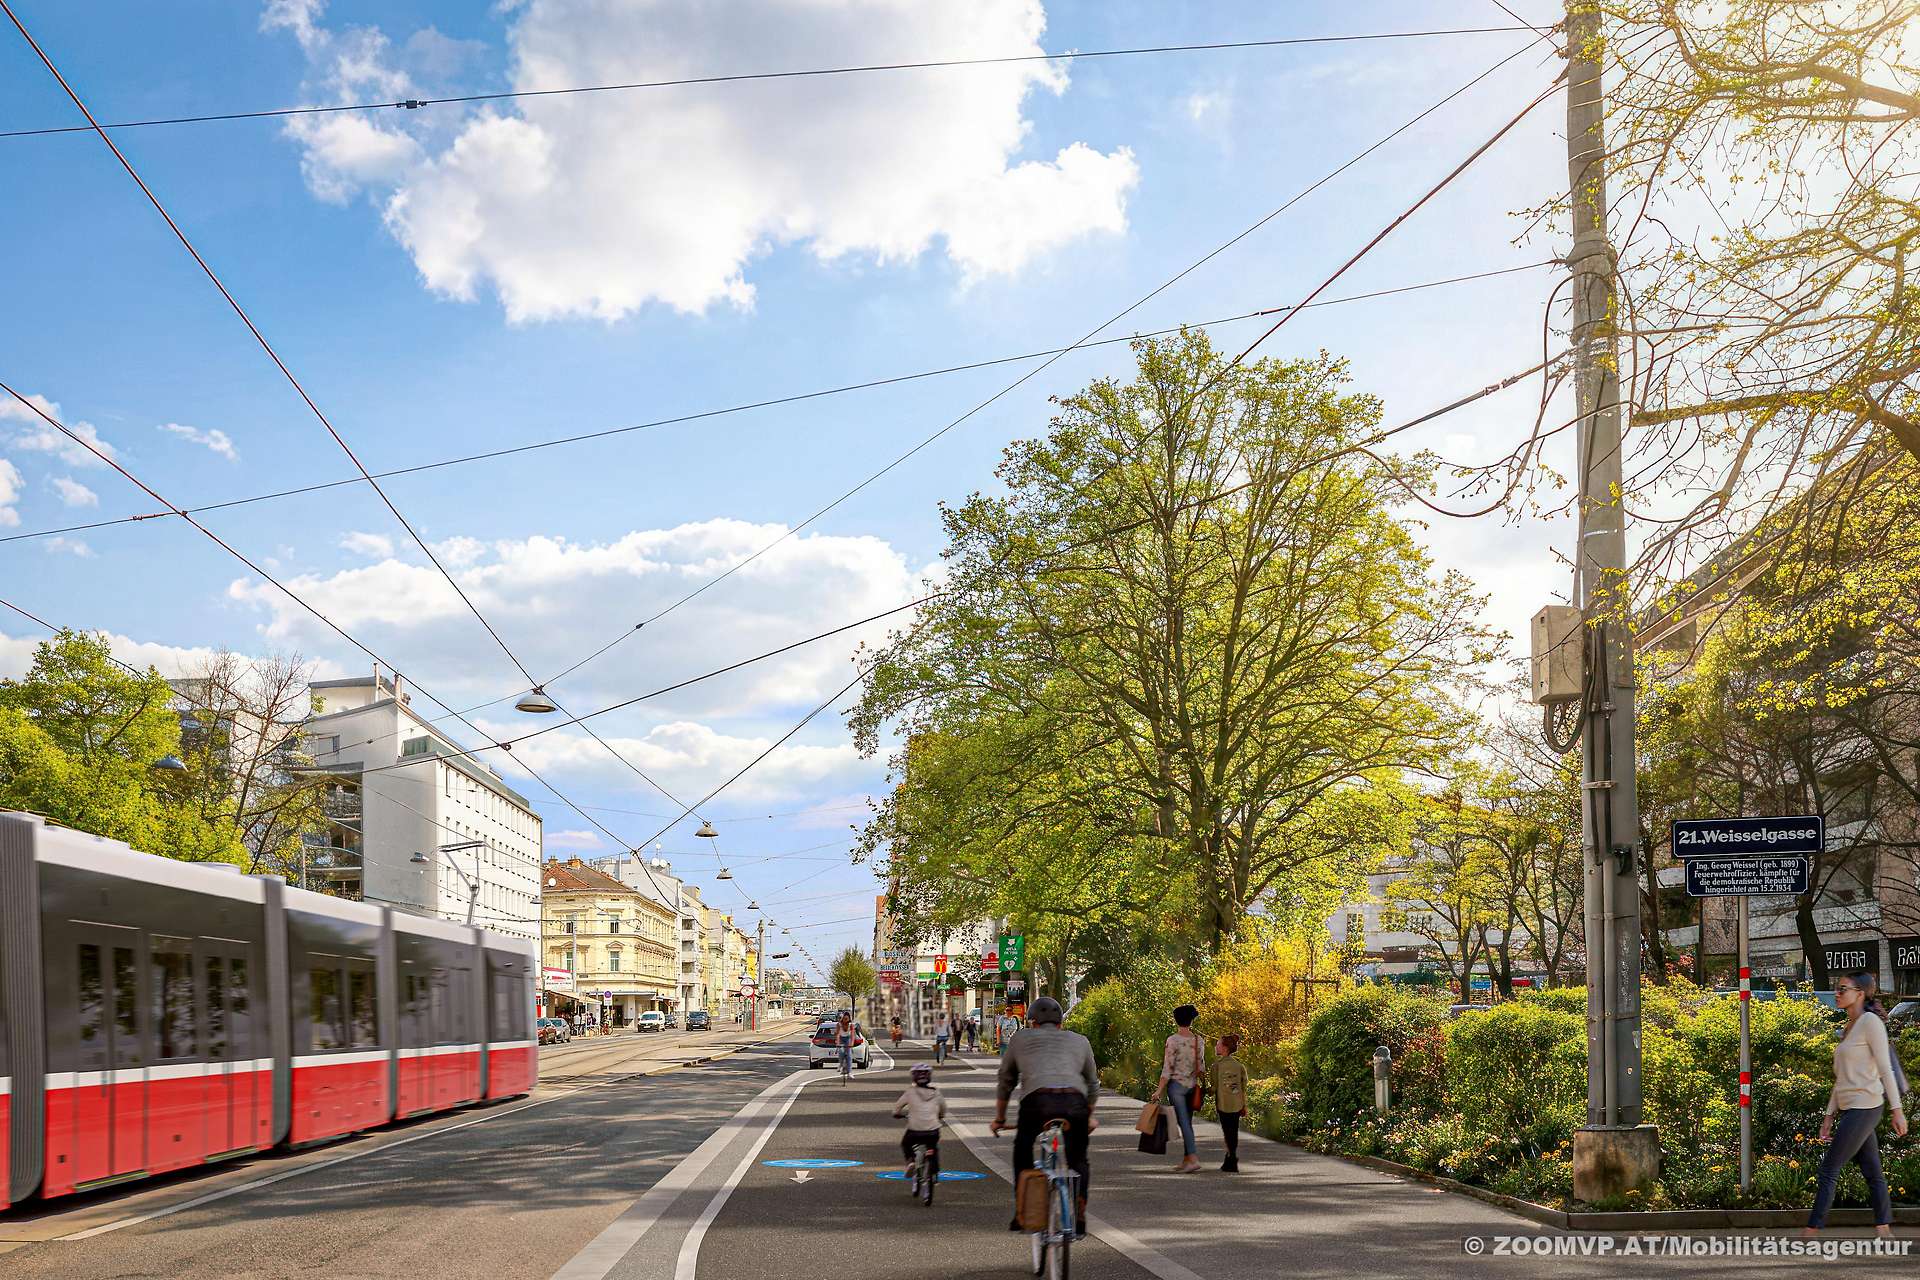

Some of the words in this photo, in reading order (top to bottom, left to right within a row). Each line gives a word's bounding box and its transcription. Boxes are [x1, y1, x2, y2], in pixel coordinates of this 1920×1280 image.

[1696, 861, 1710, 871] Ing.
[1711, 861, 1732, 871] Georg
[1732, 860, 1759, 869] Weissel
[1780, 859, 1799, 869] 1899)
[1759, 868, 1788, 878] kämpfte
[1789, 868, 1800, 876] für
[1699, 877, 1711, 886] die
[1712, 877, 1763, 886] demokratische
[1764, 876, 1796, 886] Republik
[1705, 885, 1747, 895] hingerichtet
[1761, 884, 1791, 892] 15.2.1934
